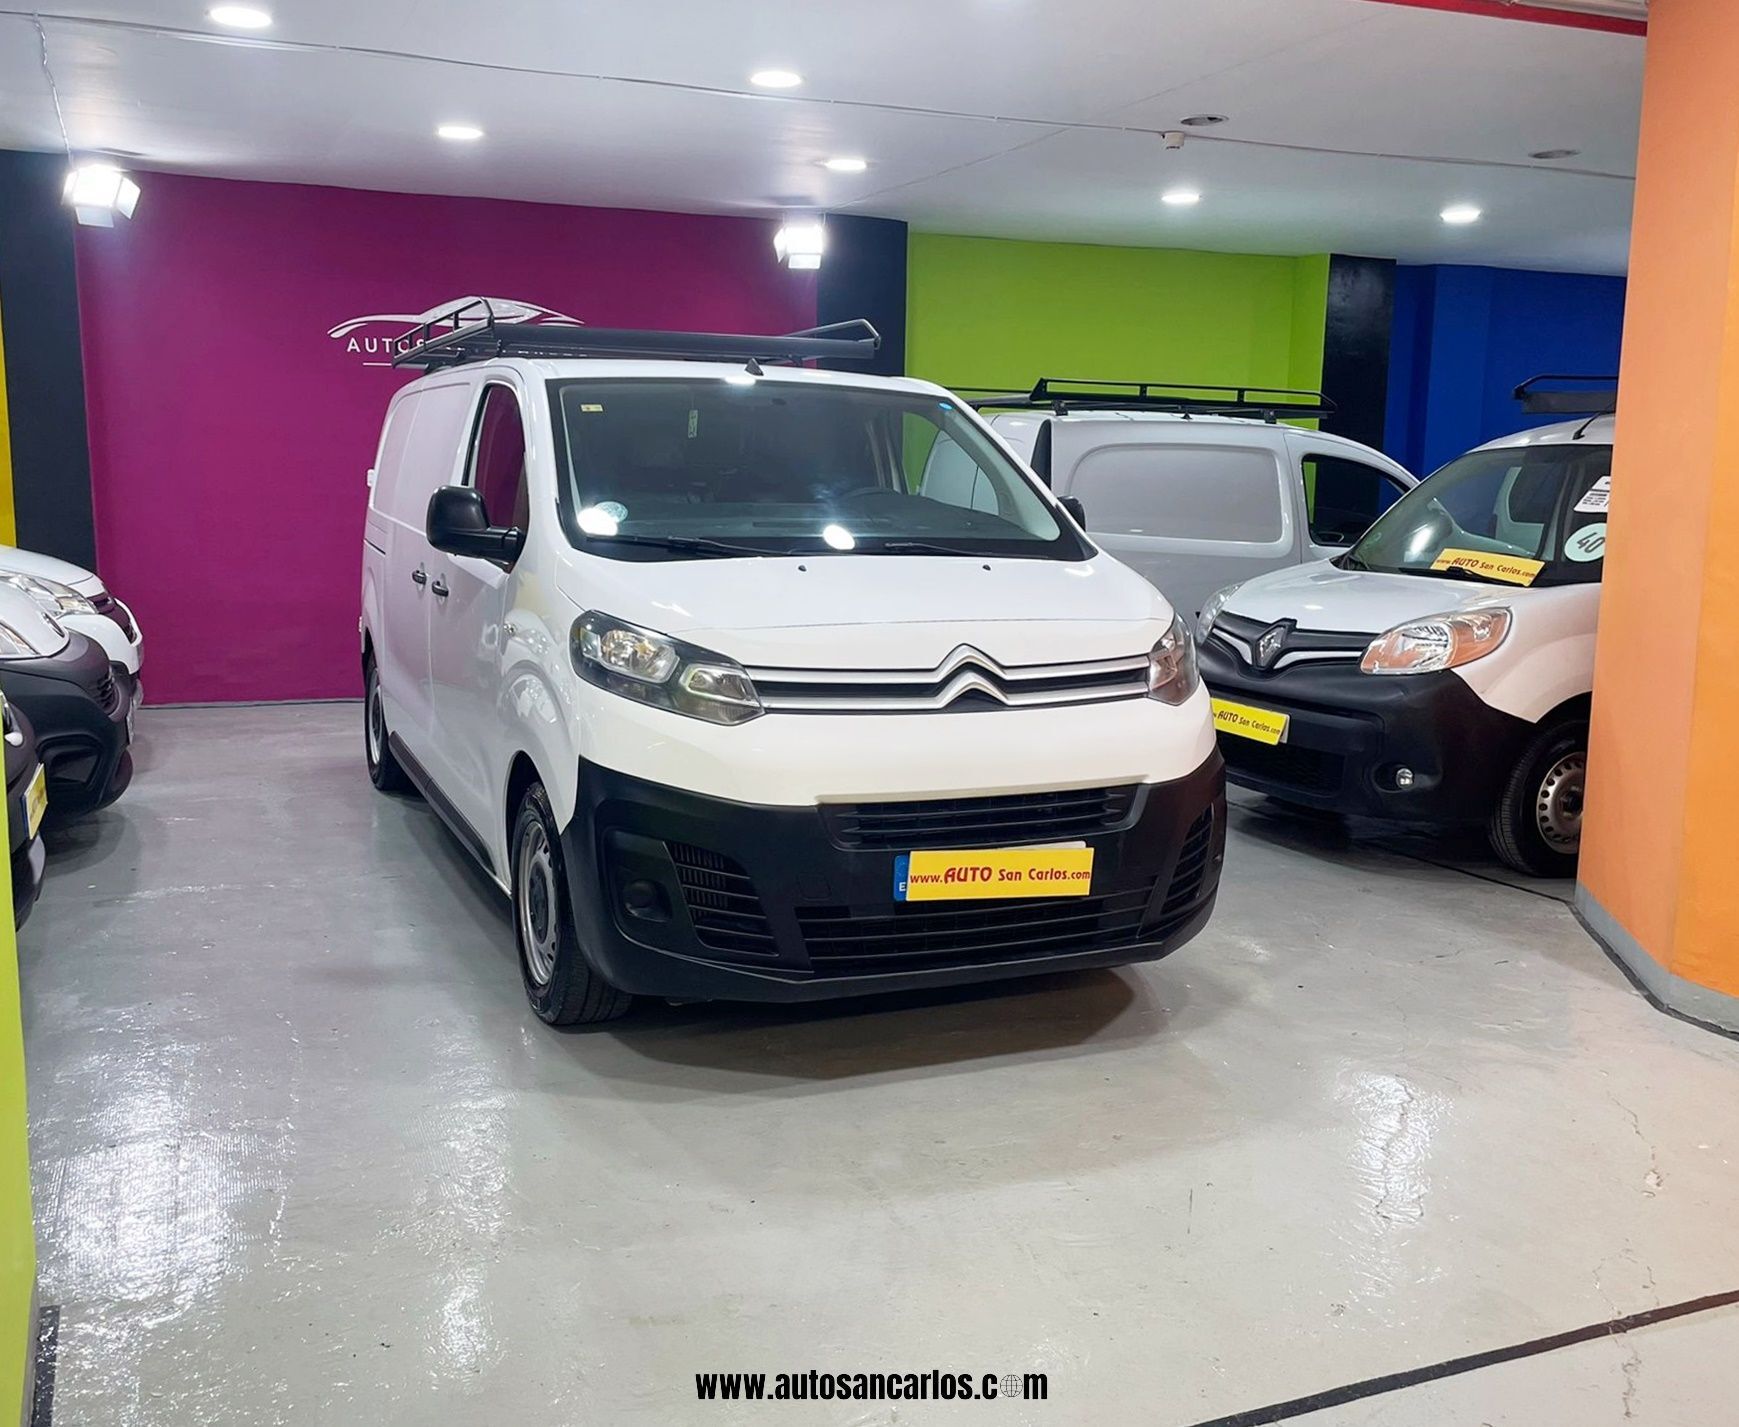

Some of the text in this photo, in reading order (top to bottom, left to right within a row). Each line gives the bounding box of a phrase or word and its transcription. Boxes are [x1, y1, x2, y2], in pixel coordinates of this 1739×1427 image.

[1577, 532, 1606, 553] 40
[1479, 562, 1494, 570] San
[910, 866, 1091, 884] www.AUTO San Carlos.com
[899, 881, 906, 892] E
